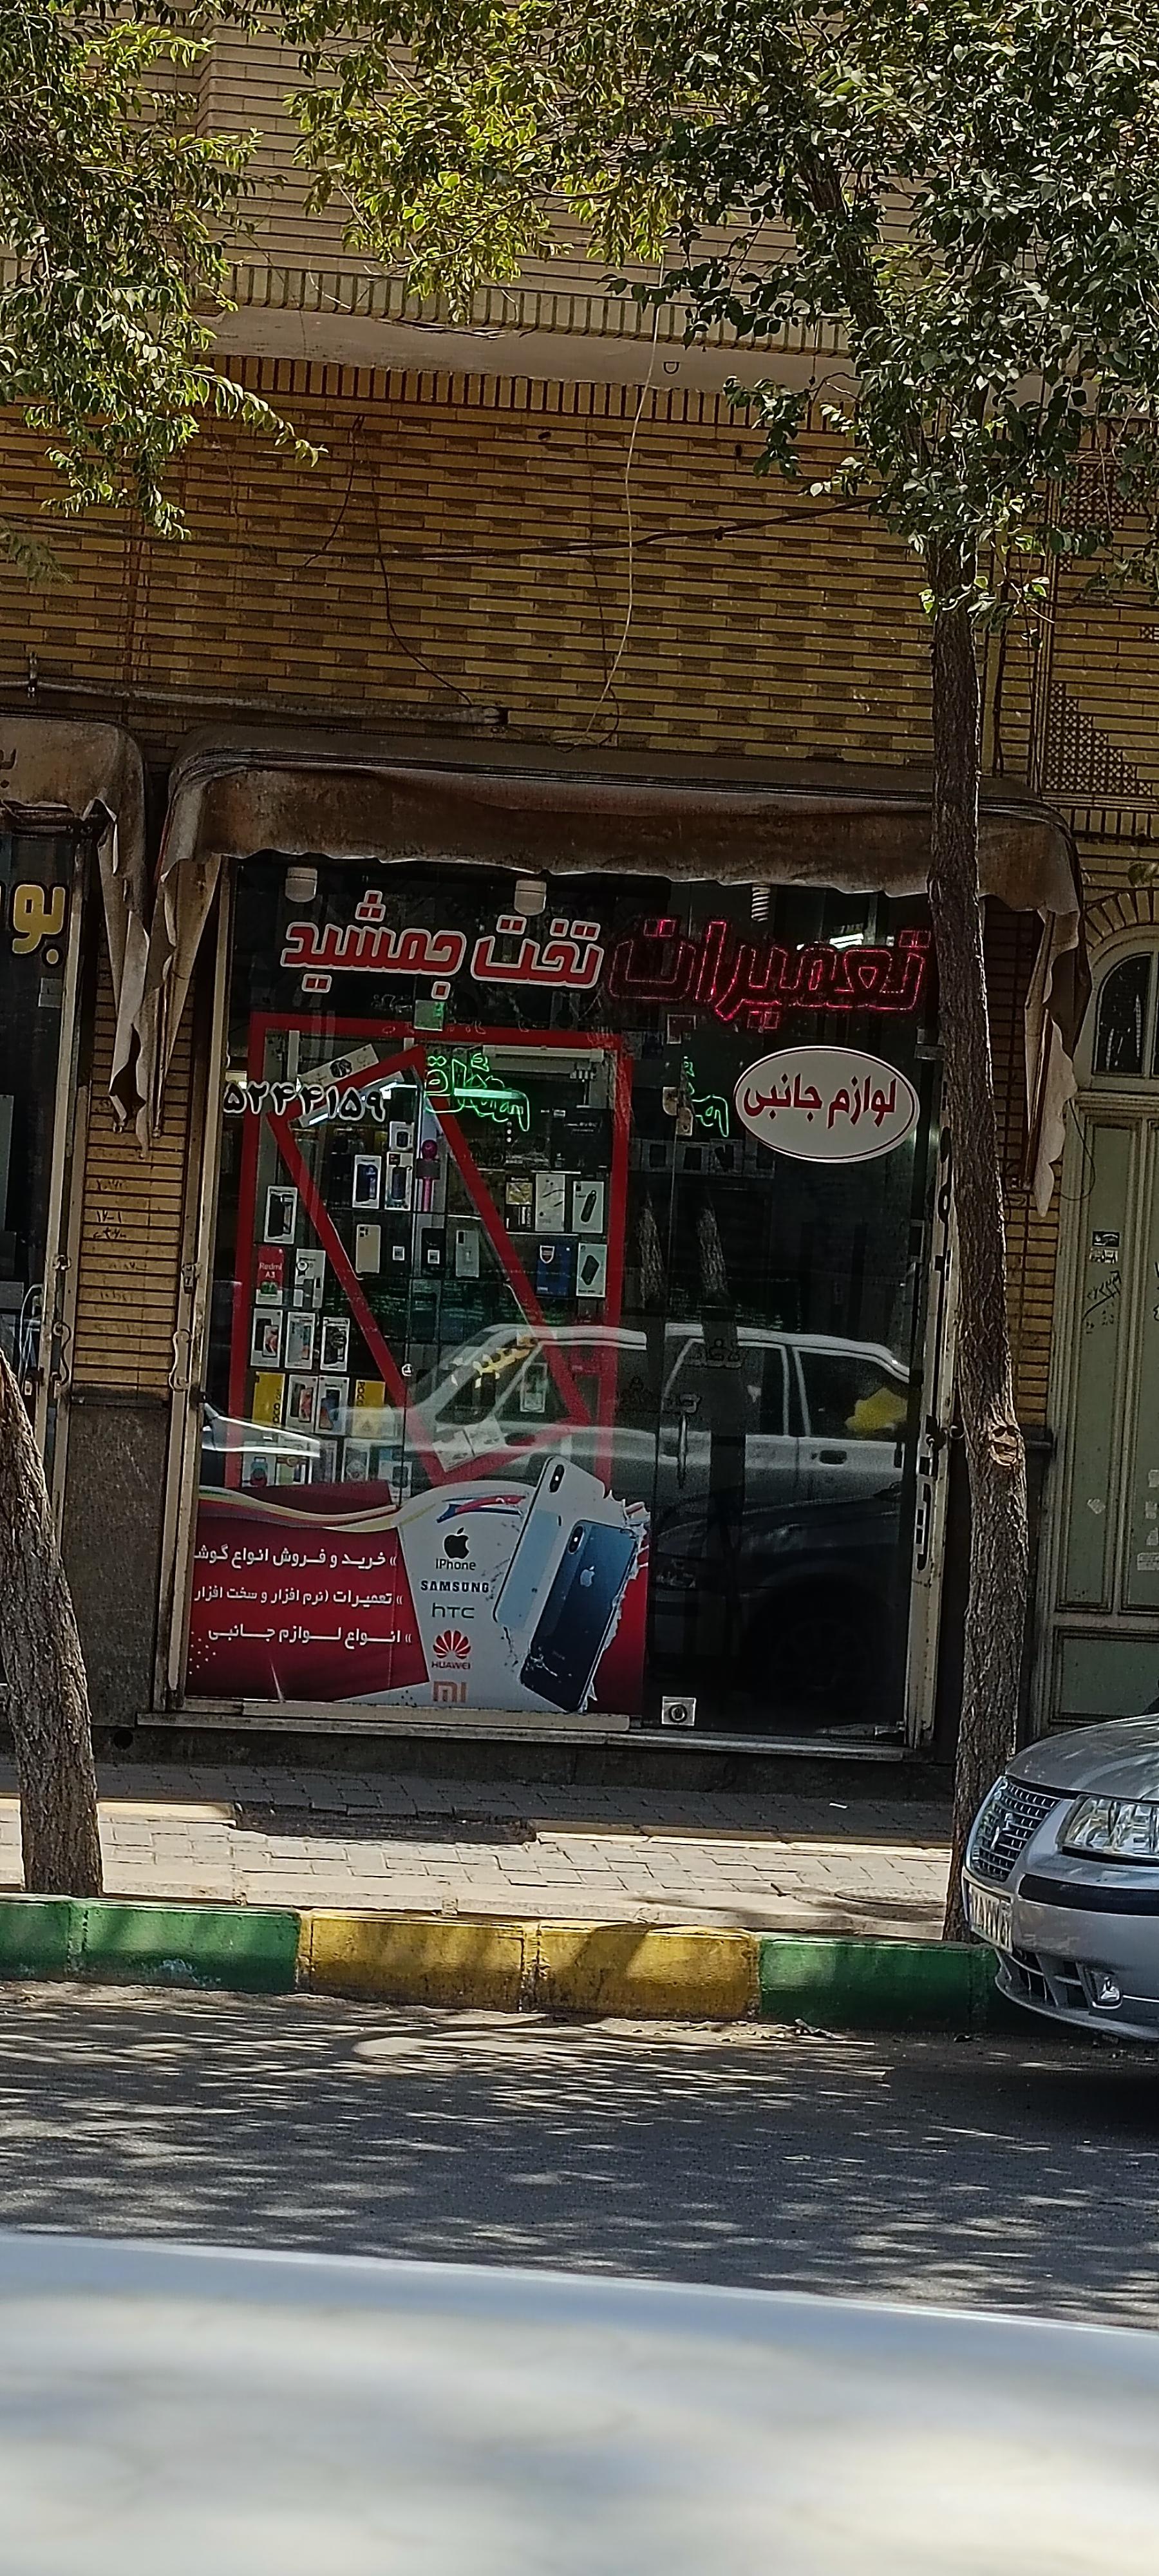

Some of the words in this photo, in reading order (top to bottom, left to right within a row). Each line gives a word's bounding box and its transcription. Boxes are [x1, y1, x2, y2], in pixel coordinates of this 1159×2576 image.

[0, 882, 66, 966] بو
[279, 890, 467, 1000] جمشید
[471, 914, 605, 990] تخت
[608, 917, 931, 1031] تعمیرات
[223, 1080, 386, 1123] ۵۲۴۴۱۵۹
[743, 1073, 823, 1122] جانبی
[827, 1076, 897, 1129] لوازم
[259, 1262, 283, 1271] Redmi
[272, 1403, 281, 1425] OCO
[194, 1544, 229, 1564] گوش
[231, 1547, 269, 1569] انواع
[272, 1547, 326, 1567] فروش
[330, 1553, 338, 1568] و
[341, 1551, 386, 1569] خرید
[194, 1585, 223, 1602] افزار
[226, 1586, 258, 1600] سخت
[270, 1587, 299, 1605] افزار
[420, 1580, 489, 1593] SAMSUNG
[260, 1591, 268, 1604] و
[333, 1589, 393, 1608] تعمیرات
[207, 1623, 276, 1642] جانبی
[279, 1625, 342, 1644] لوازم
[344, 1628, 400, 1649] انواع
[431, 1661, 471, 1669] HUAWEI
